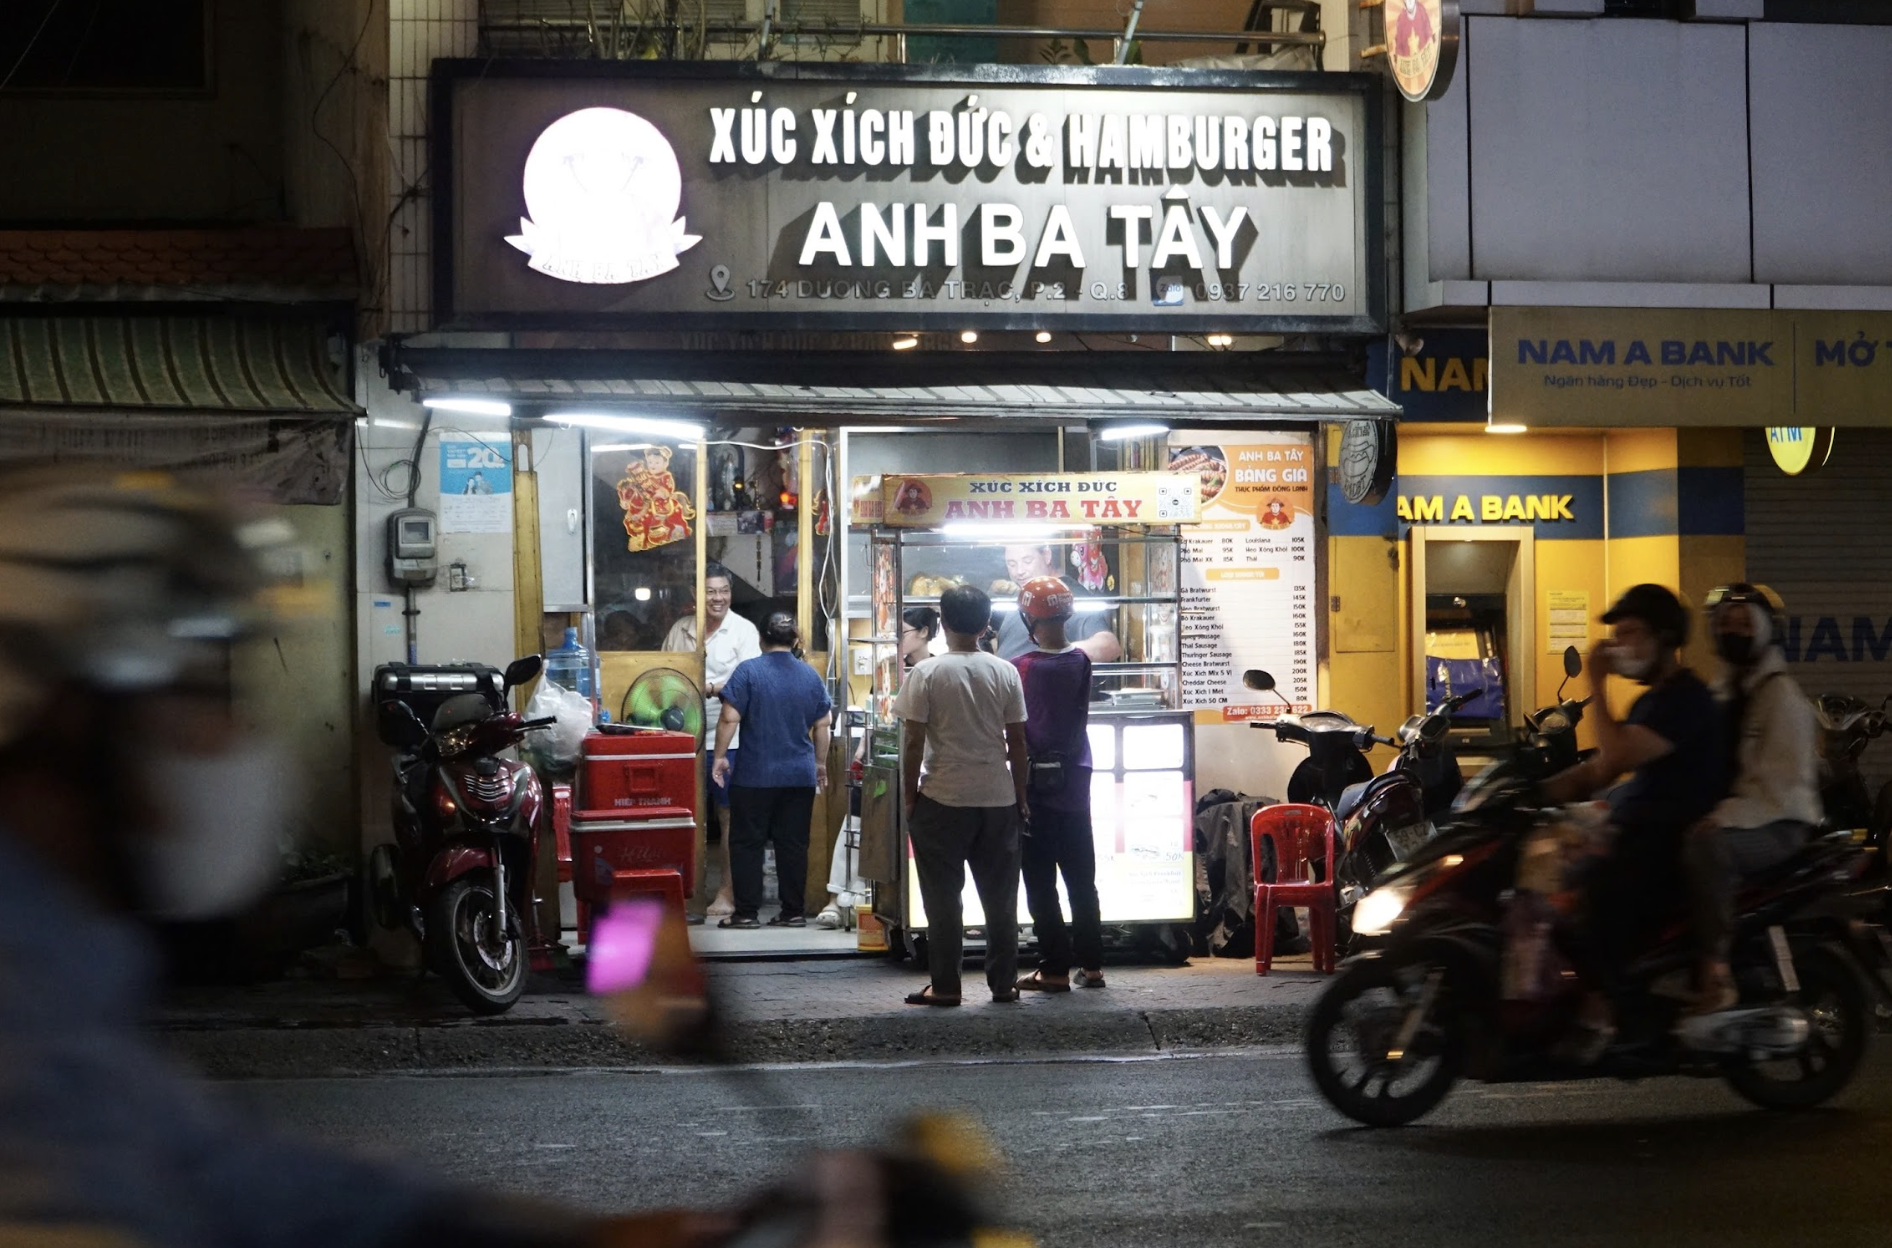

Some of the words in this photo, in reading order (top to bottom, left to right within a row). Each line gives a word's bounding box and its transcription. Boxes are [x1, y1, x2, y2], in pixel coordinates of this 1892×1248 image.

[709, 91, 797, 164] XÚC
[811, 92, 915, 165] XÍCH
[928, 94, 1012, 168] ĐỨC
[1026, 113, 1054, 168] &
[1067, 113, 1332, 171] HAMBURGER
[798, 201, 958, 266] ANH
[981, 203, 1087, 268] BA
[1110, 183, 1249, 269] TÂY
[747, 280, 788, 298] 174
[1030, 282, 1066, 300] P.2
[1090, 282, 1128, 300] Q.8
[1195, 282, 1249, 300] 0937
[1257, 282, 1296, 301] 216
[1305, 283, 1345, 301] 770
[1518, 339, 1615, 365] NAM
[1624, 340, 1652, 365] A
[1660, 340, 1775, 366] BANK
[1815, 330, 1879, 367] MỞ
[1238, 450, 1263, 462] ANH
[1267, 450, 1281, 462] BA
[1284, 448, 1303, 462] TÂY
[1235, 464, 1277, 483] BẢNG
[1282, 464, 1308, 483] GIÁ
[970, 480, 1012, 493] XÚC
[1018, 479, 1071, 493] XÍCH
[945, 500, 1015, 518] ANH
[1026, 500, 1070, 518] BA
[1081, 496, 1142, 518] TÂY
[1397, 495, 1443, 520] AM
[1451, 495, 1475, 520] A
[1482, 495, 1574, 520] BANK
[1227, 707, 1248, 715] Zalo:
[1250, 706, 1271, 715] 0333
[1292, 705, 1308, 713] 622
